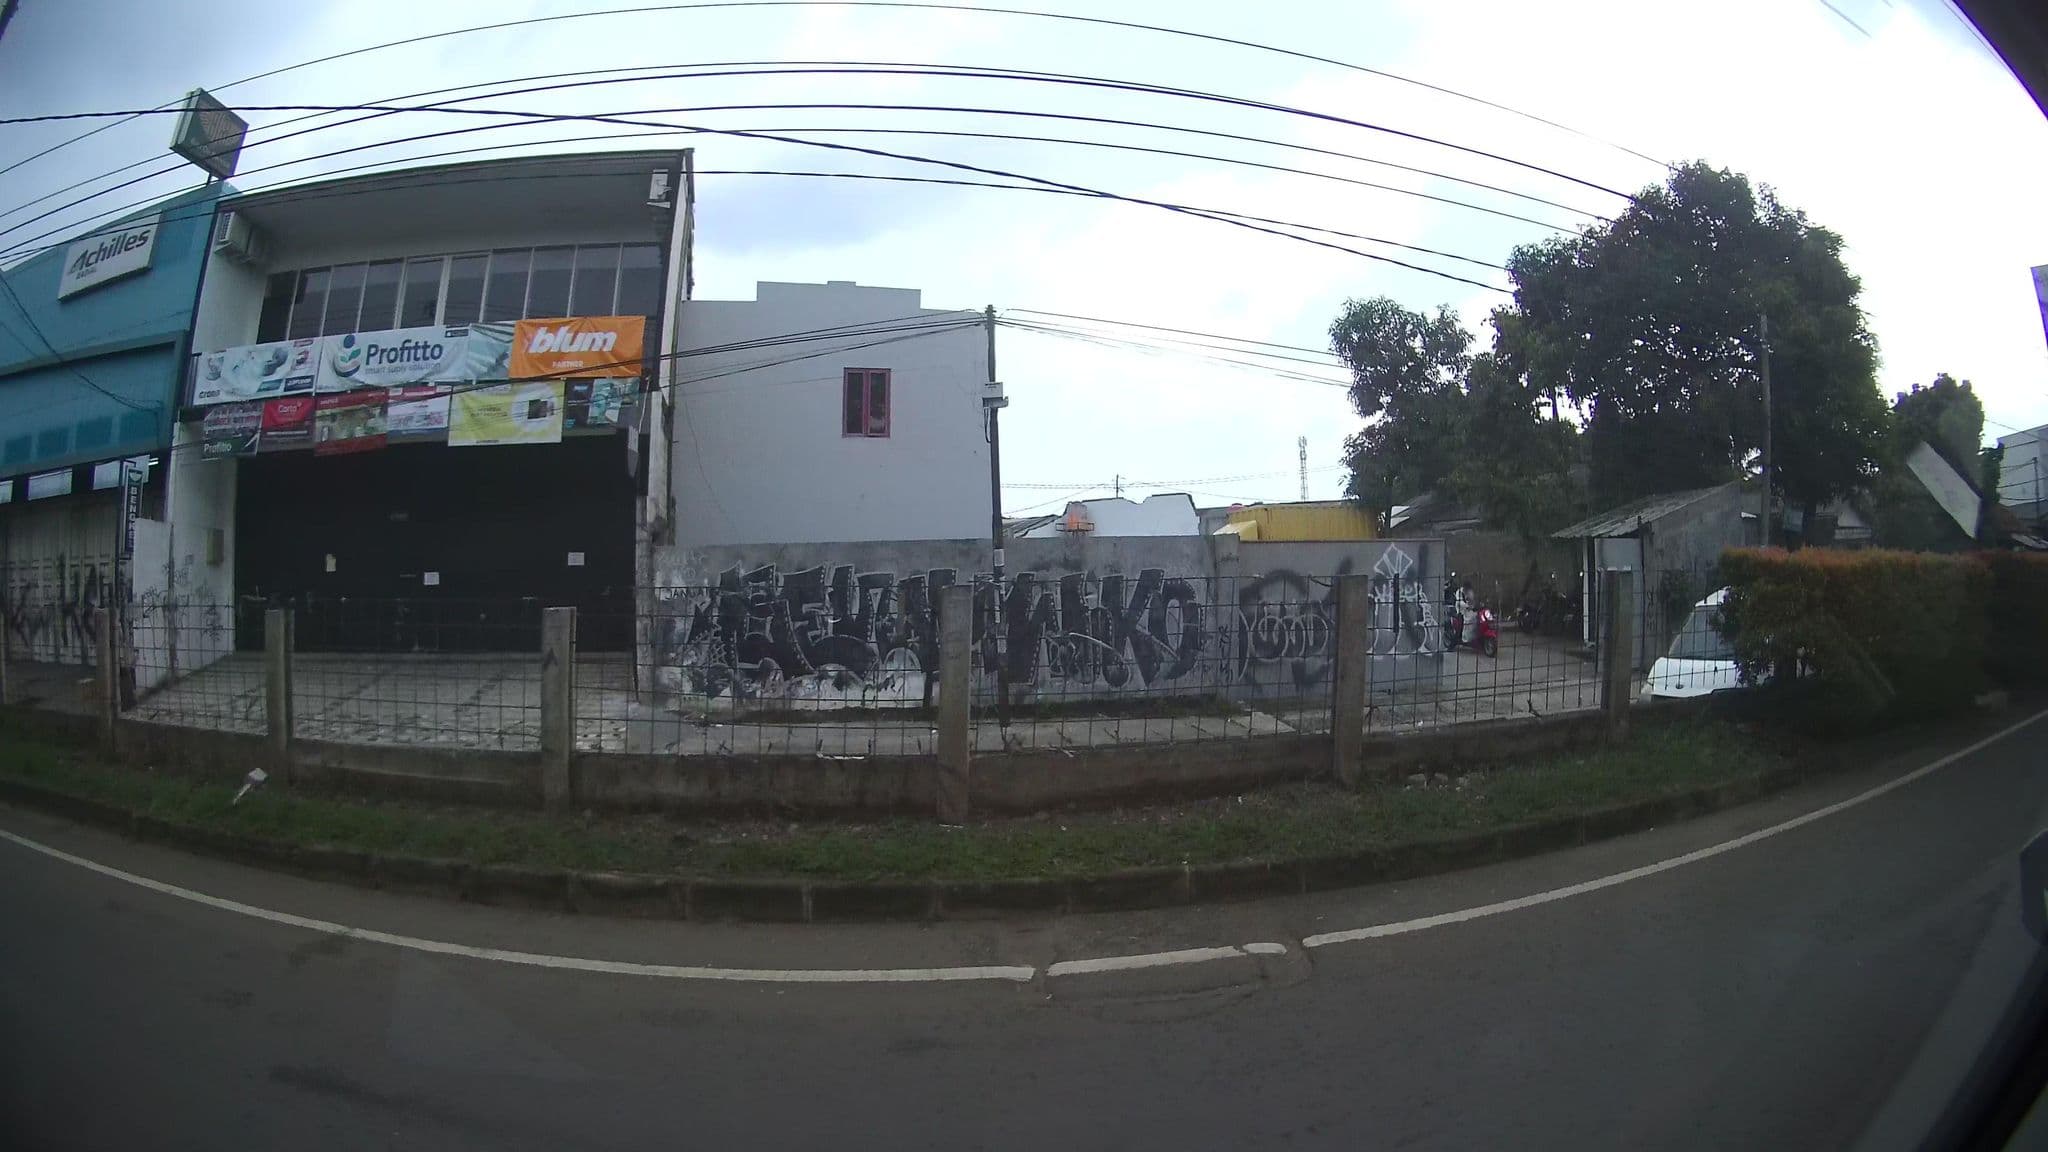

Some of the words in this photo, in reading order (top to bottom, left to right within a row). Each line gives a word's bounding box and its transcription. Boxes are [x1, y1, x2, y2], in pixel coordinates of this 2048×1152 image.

[67, 229, 151, 275] Achilles
[365, 339, 443, 366] Profitto
[528, 326, 618, 354] blum
